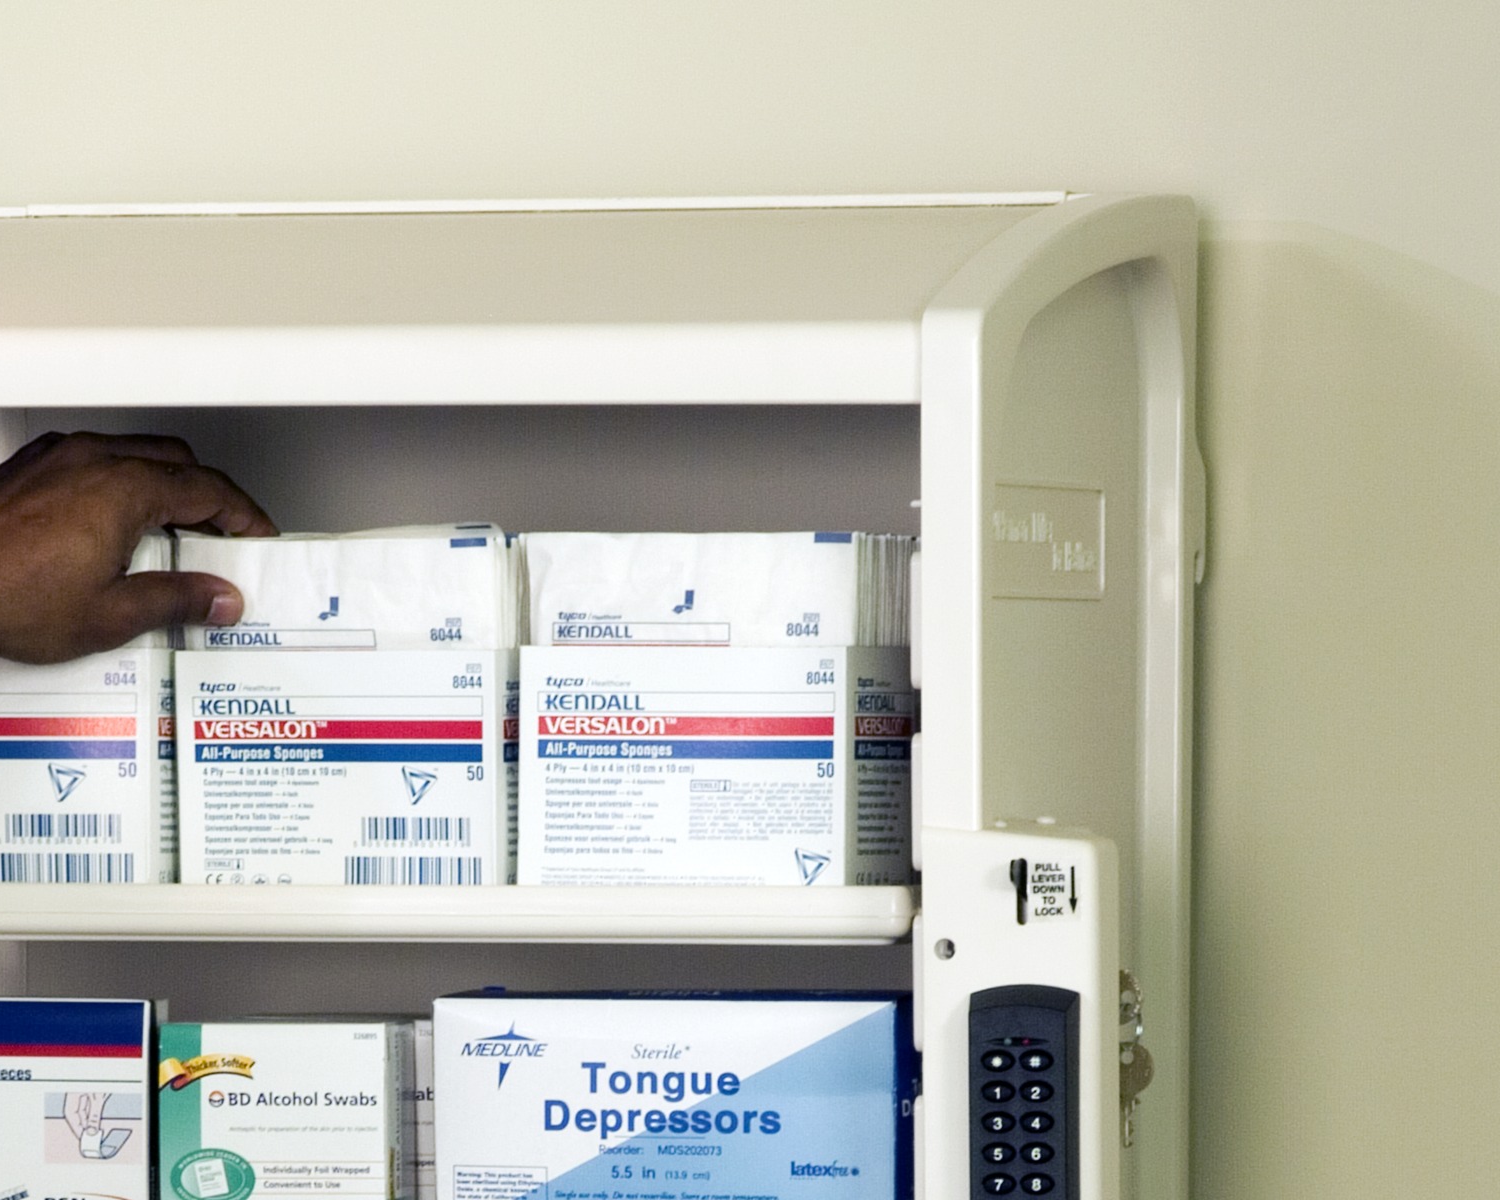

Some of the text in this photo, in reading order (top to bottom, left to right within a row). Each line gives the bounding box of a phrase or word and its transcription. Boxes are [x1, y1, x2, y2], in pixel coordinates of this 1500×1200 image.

[558, 612, 587, 621] tyco
[430, 628, 462, 642] 8044
[557, 625, 633, 638] KENDALL
[786, 623, 819, 637] 8044
[209, 633, 282, 646] KENDALL
[104, 673, 136, 685] 8044
[452, 676, 482, 688] 8044
[545, 677, 584, 688] tyco
[806, 672, 835, 685] 8044
[200, 682, 236, 694] tyco
[200, 699, 296, 715] KENDALL
[545, 694, 645, 711] KENDALL
[202, 746, 324, 761] All-Purpose Sponges
[546, 742, 673, 758] All-Purpose Sponges
[118, 762, 137, 777] 50
[210, 767, 223, 777] Ply
[238, 767, 244, 775] 4
[263, 767, 269, 776] 4
[271, 768, 279, 776] in
[466, 765, 484, 781] 50
[553, 764, 567, 773] Ply
[583, 764, 588, 772] 4
[591, 764, 598, 772] in
[608, 764, 613, 772] 4
[616, 764, 624, 772] in
[643, 765, 656, 773] cm
[817, 762, 835, 778] 50
[1035, 863, 1061, 872] PULL
[1031, 874, 1065, 883] LEVER
[1033, 885, 1064, 893] DOWN
[1042, 896, 1056, 904] TO
[1035, 907, 1063, 916] LOCK
[461, 1043, 548, 1057] MEDLINE
[581, 1062, 740, 1102] Tongue
[228, 1092, 377, 1106] BD Alcohol Swabs
[994, 1086, 1001, 1099] 1
[1030, 1086, 1041, 1100] 2
[544, 1100, 781, 1139] Depressors
[992, 1117, 1003, 1130] 3
[1030, 1117, 1041, 1130] 4
[599, 1145, 722, 1156] Reorder: MDS202073
[993, 1148, 1003, 1161] 5
[1031, 1147, 1041, 1161] 6
[263, 1166, 370, 1176] Individually Foil Wrapped
[611, 1166, 710, 1180] 5.5 in (13.9 cm)
[264, 1181, 312, 1189] Convenient
[993, 1178, 1004, 1192] 7
[1031, 1178, 1041, 1191] 8
